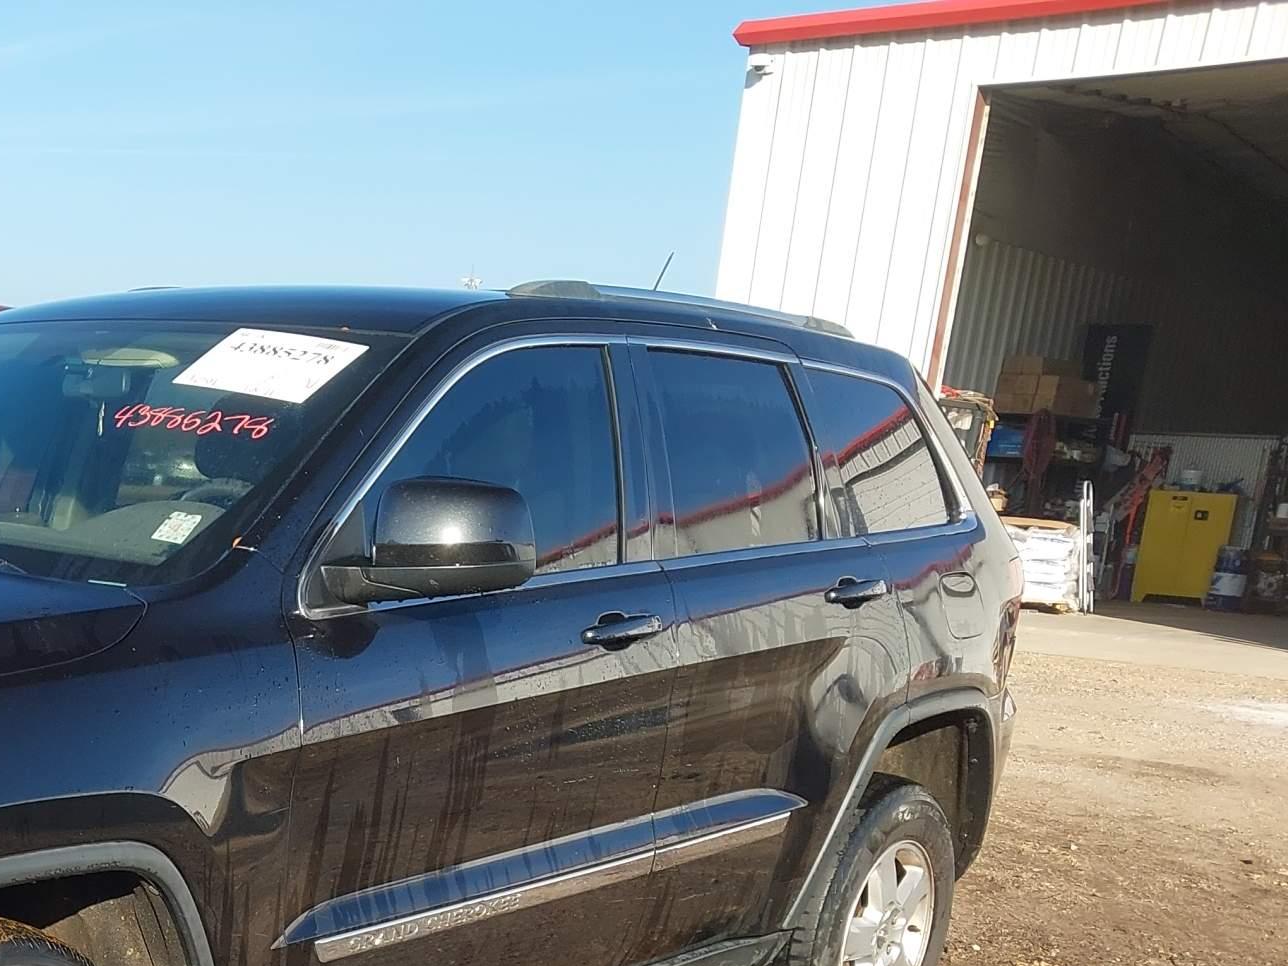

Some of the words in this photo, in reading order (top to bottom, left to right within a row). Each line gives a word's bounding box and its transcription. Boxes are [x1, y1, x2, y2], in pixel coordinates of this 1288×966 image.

[231, 342, 334, 364] 43885278
[349, 922, 419, 950] GRAND
[426, 893, 522, 930] CHEROKEE
